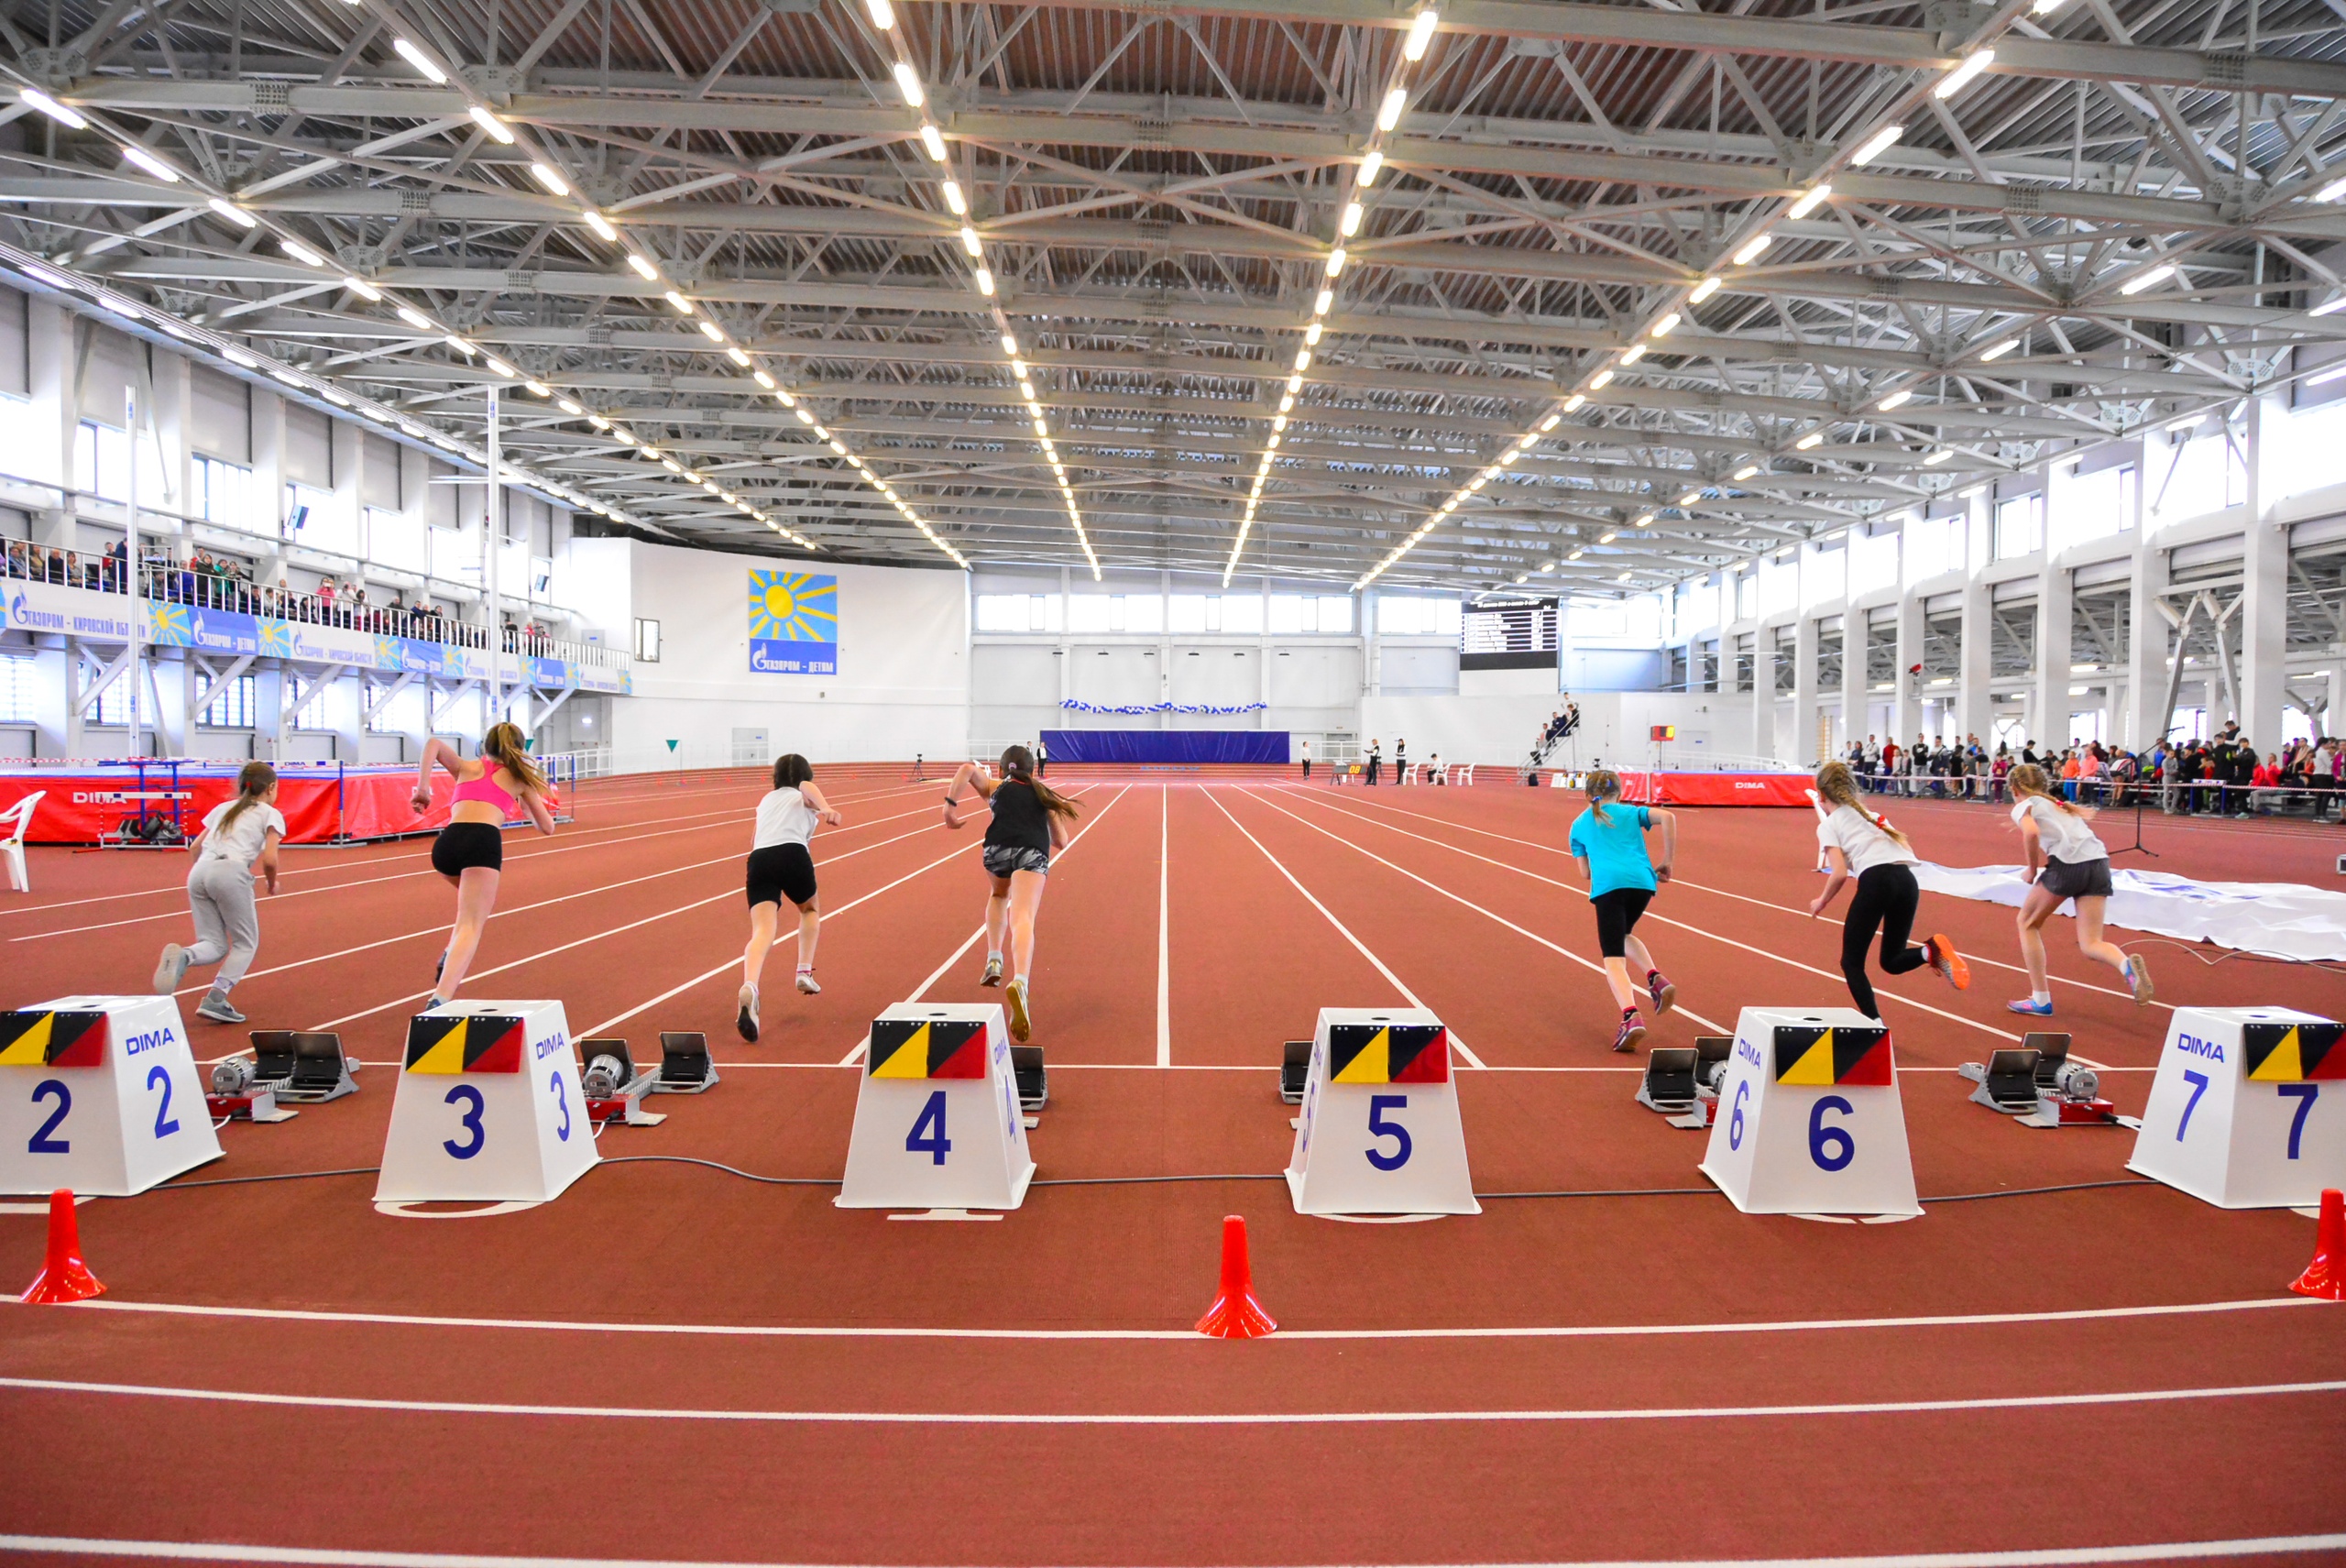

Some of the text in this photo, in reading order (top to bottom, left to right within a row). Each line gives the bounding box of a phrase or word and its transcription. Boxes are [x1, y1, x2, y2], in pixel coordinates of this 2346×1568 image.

[28, 610, 64, 629] ГАЗПРОМ
[73, 616, 115, 635] КИРОВСКОЙ
[116, 621, 147, 638] ОБЛТИ
[767, 659, 800, 671] ГАЗПРОМ
[808, 661, 833, 673] ДЕТЯМ
[126, 1027, 175, 1056] DIMA
[535, 1032, 565, 1060] DIMA
[1738, 1037, 1761, 1070] DIMA
[2177, 1033, 2224, 1063] DIMA
[28, 1080, 71, 1154] 2
[147, 1065, 180, 1139] 2
[443, 1084, 485, 1160] 3
[550, 1070, 570, 1142] 3
[905, 1091, 951, 1166] 4
[1365, 1094, 1412, 1171] 5
[1729, 1079, 1749, 1152] 6
[1808, 1095, 1855, 1172] 6
[2176, 1069, 2209, 1143] 7
[2277, 1084, 2319, 1160] 7
